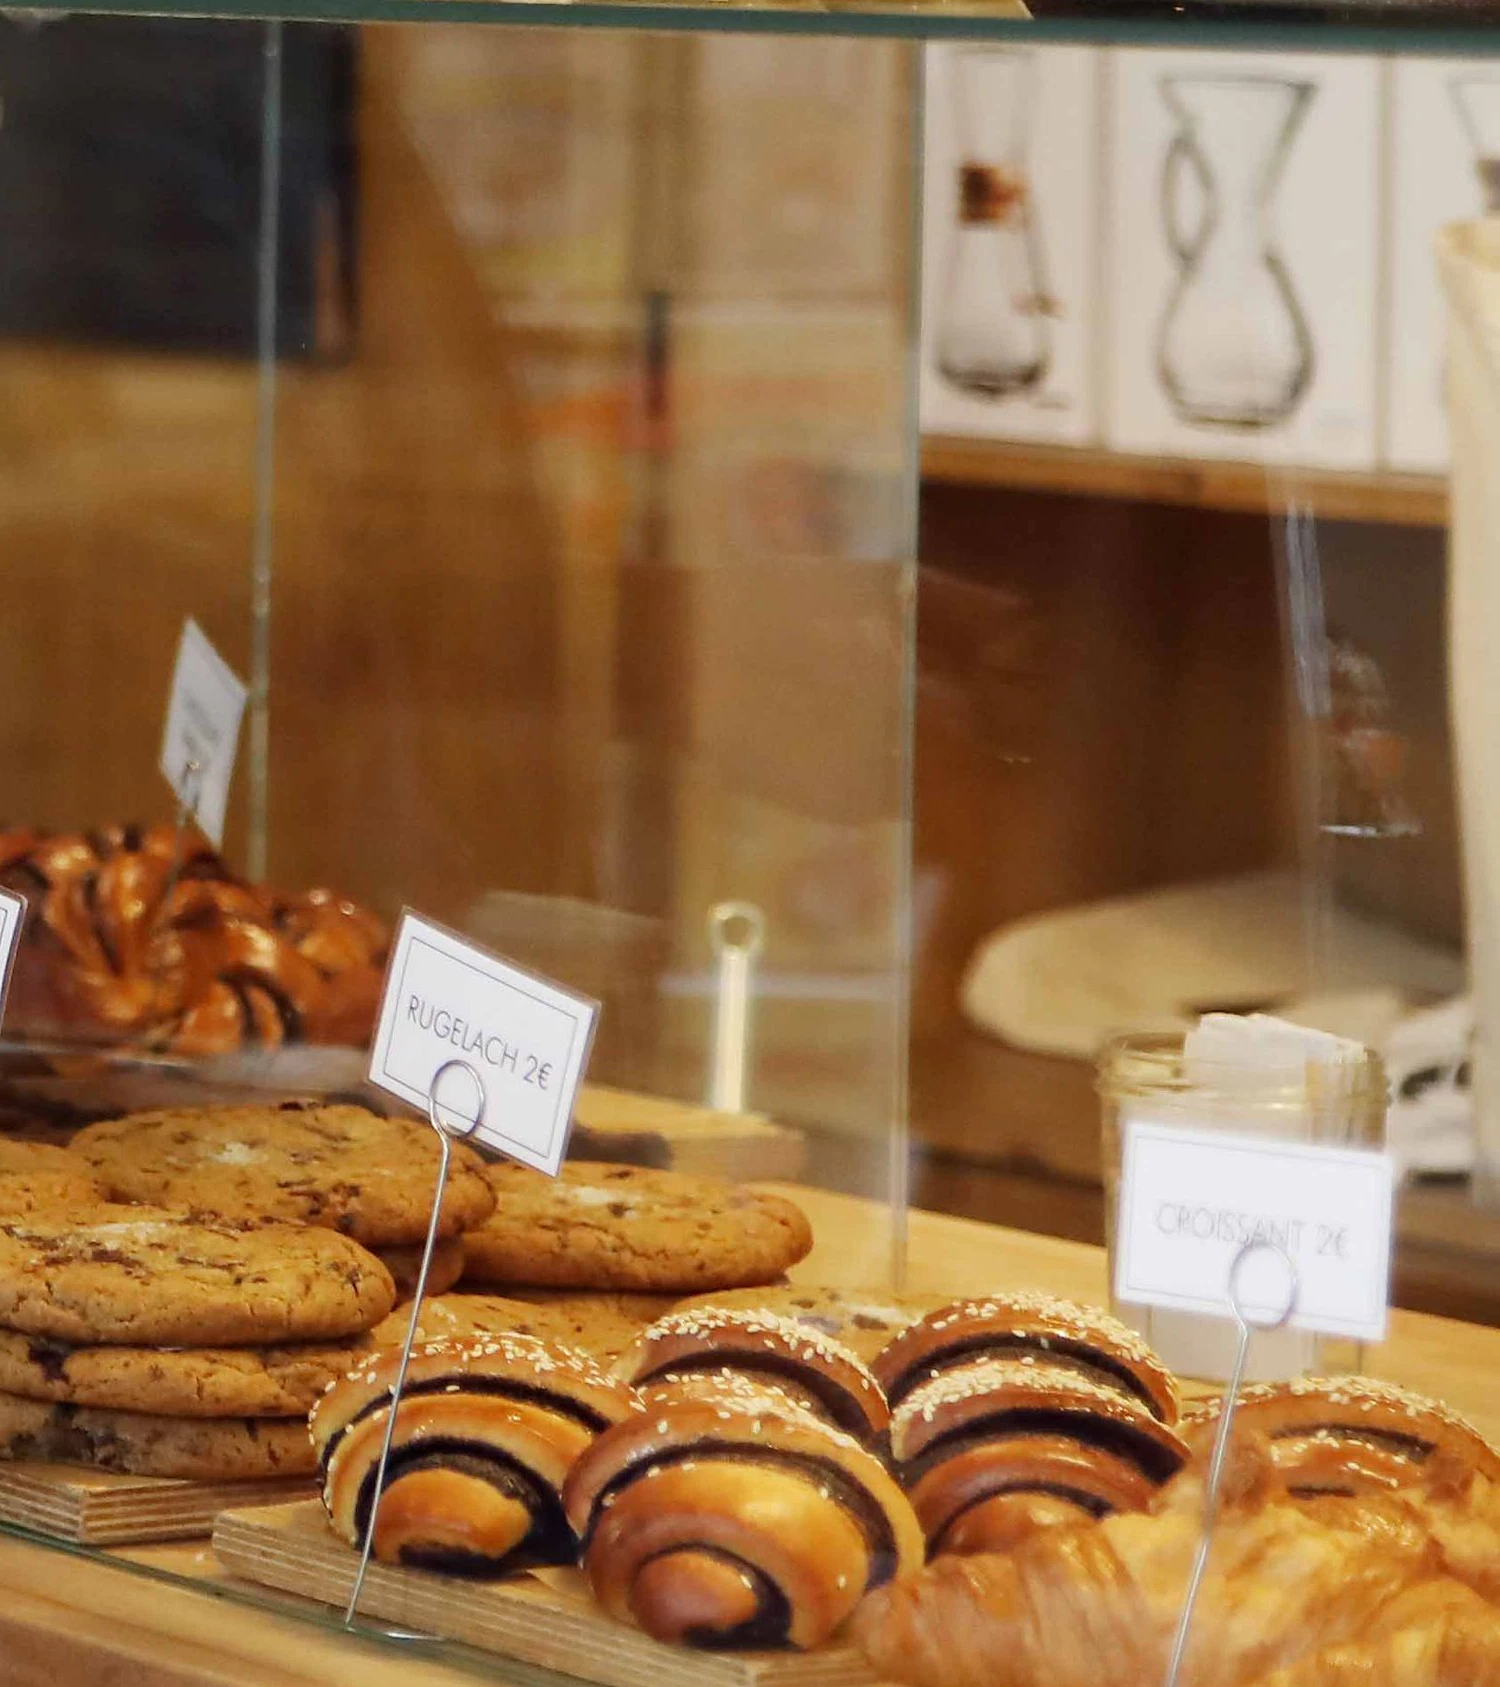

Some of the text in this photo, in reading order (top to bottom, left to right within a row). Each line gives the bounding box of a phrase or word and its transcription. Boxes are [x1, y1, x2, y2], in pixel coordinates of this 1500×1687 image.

[407, 995, 553, 1091] RUGELACH 2€
[1155, 1202, 1350, 1261] CROISSANT 2€
